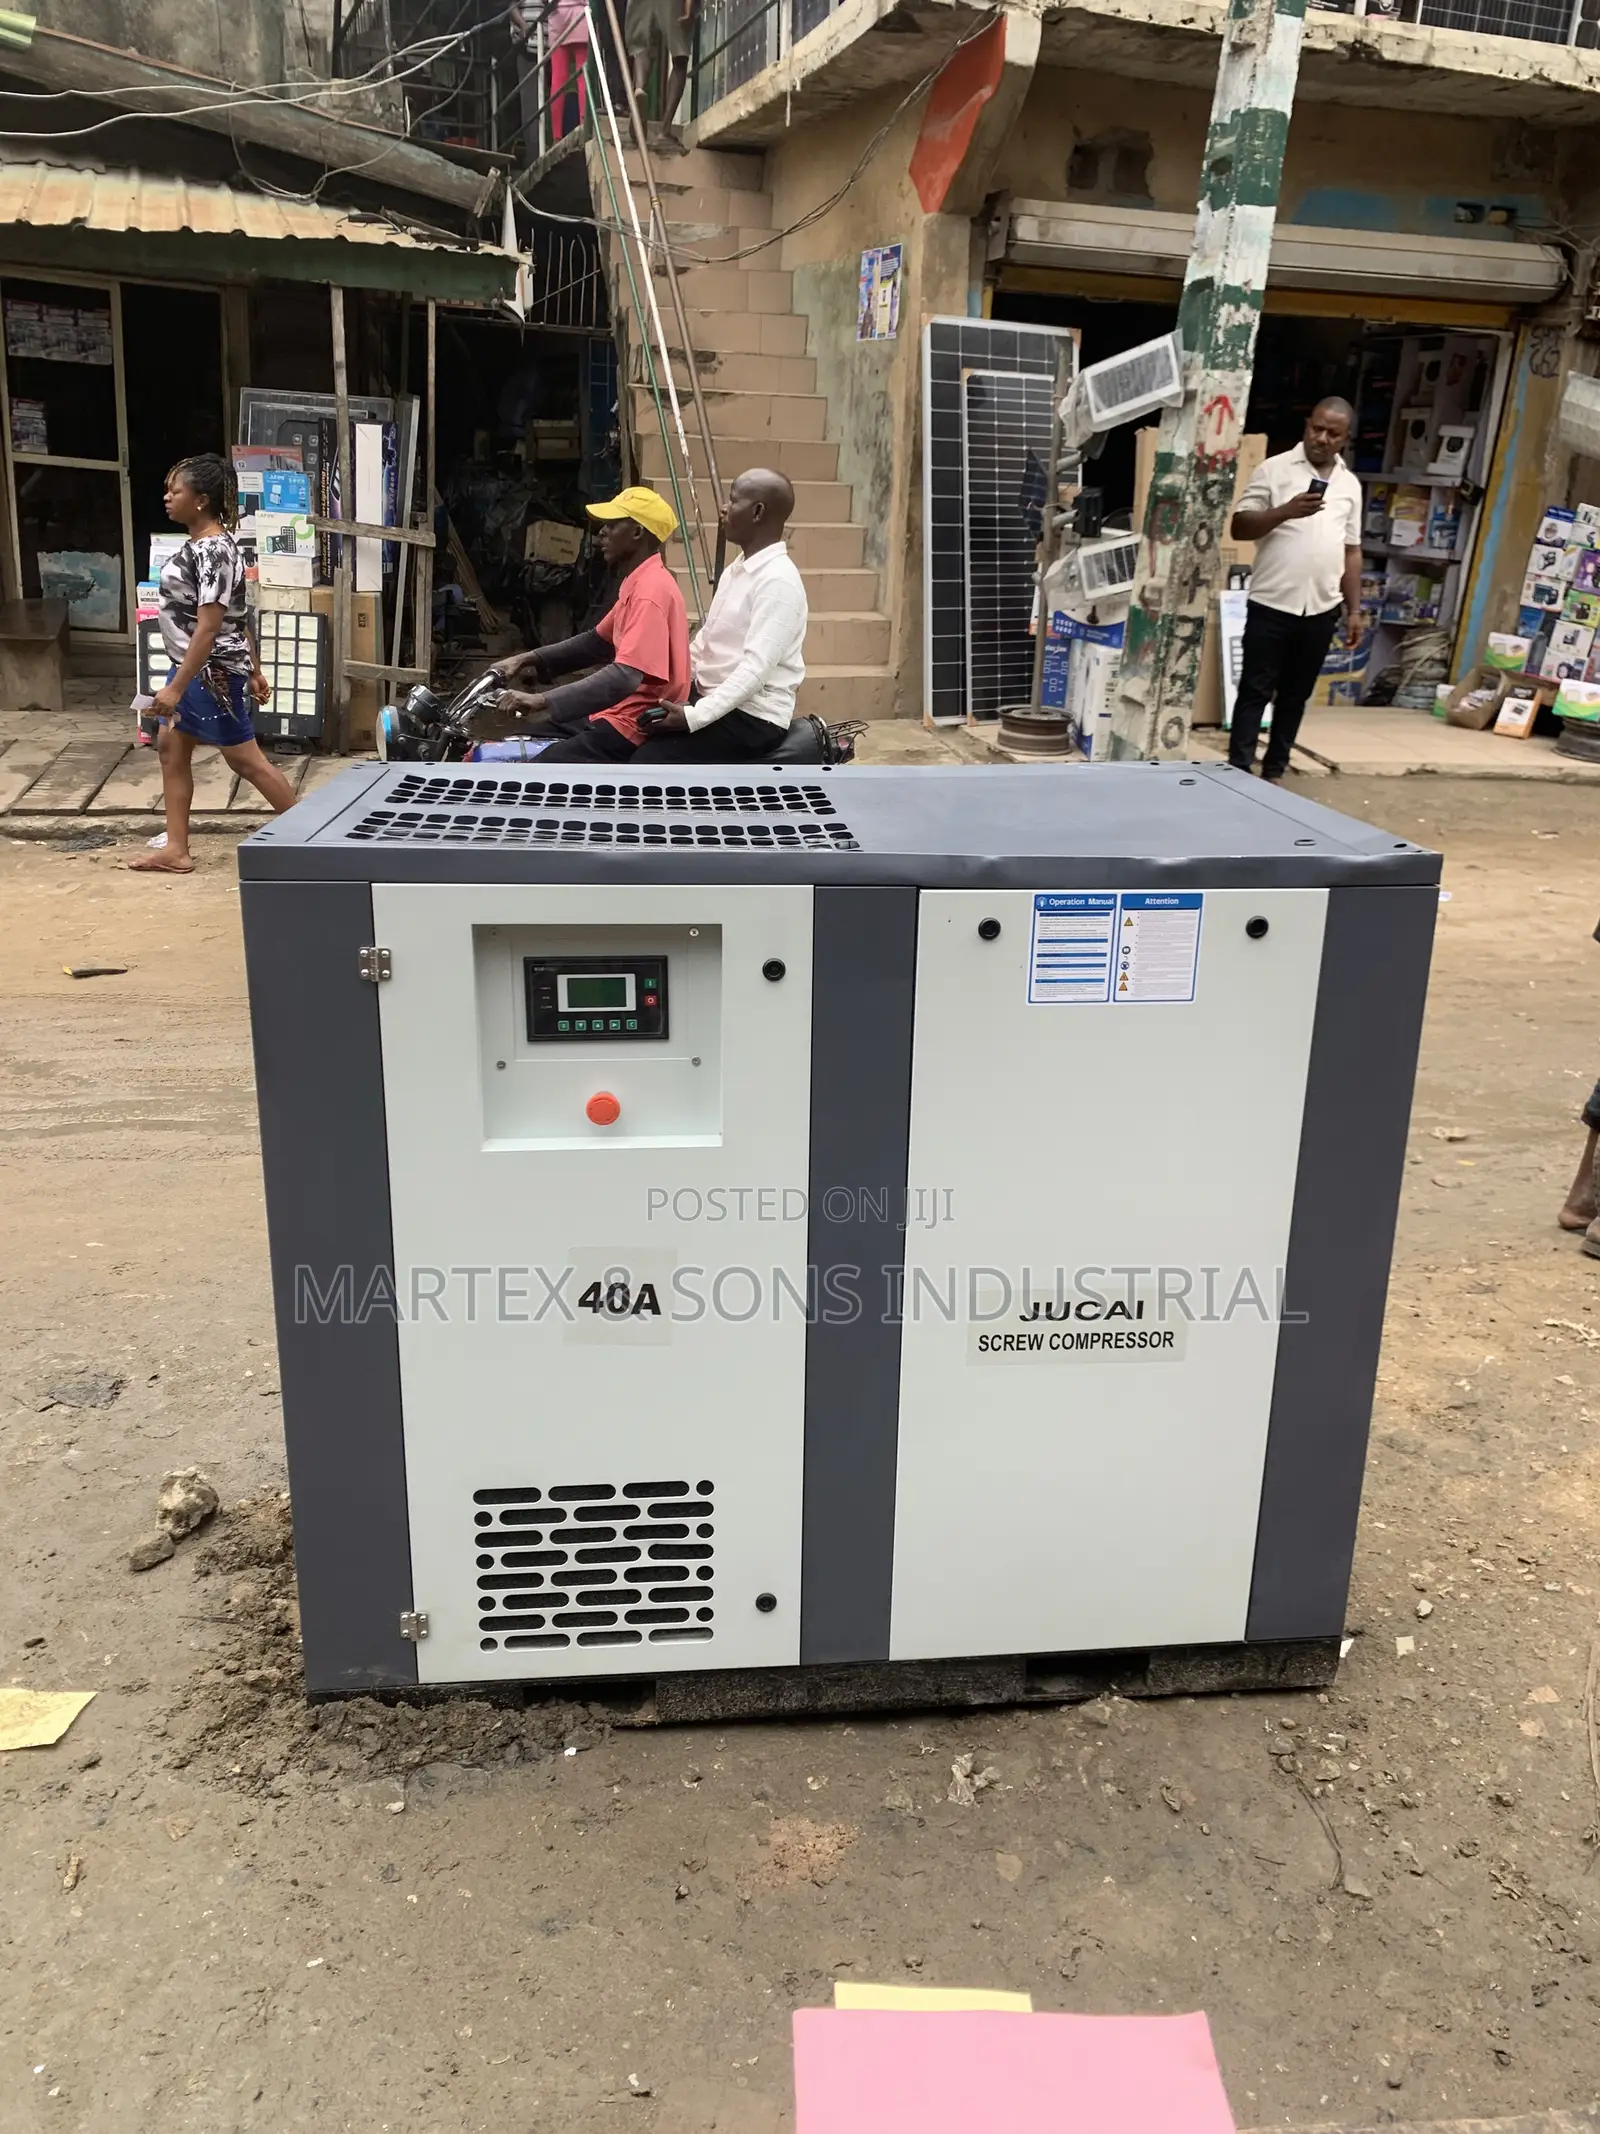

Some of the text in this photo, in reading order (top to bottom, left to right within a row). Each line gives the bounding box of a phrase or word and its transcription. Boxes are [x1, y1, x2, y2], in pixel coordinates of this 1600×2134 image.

[1048, 897, 1115, 906] Operation Manual
[1144, 896, 1180, 905] Attention
[577, 1281, 662, 1316] 40A
[1018, 1300, 1145, 1323] JUCAI
[977, 1330, 1176, 1353] SCREW COMPRESSOR
